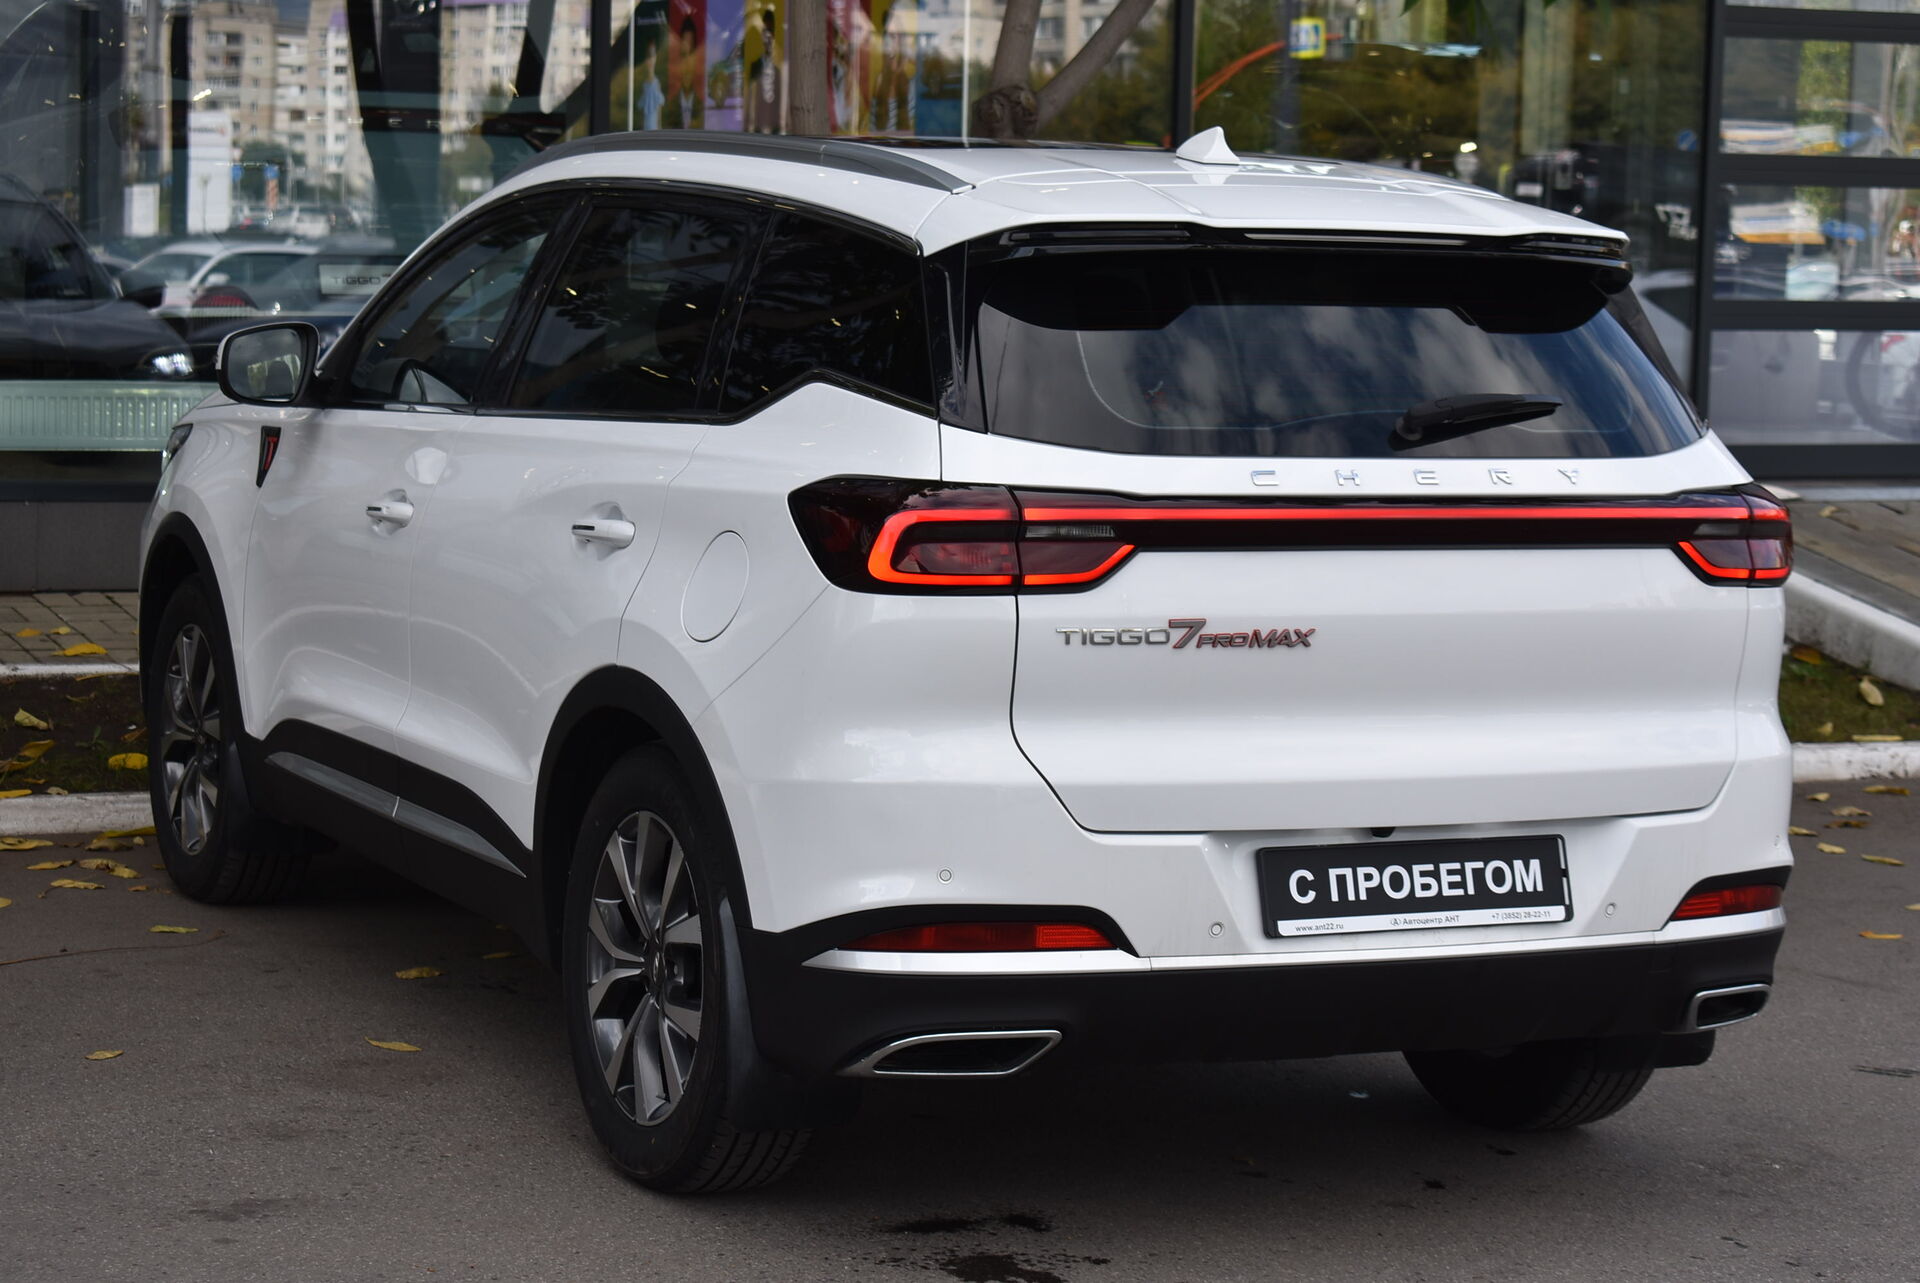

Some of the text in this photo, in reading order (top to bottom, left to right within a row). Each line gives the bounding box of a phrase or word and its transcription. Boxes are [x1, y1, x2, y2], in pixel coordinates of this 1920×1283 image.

[332, 276, 380, 285] TIGGO
[1250, 468, 1579, 487] CHERY
[1055, 627, 1170, 646] TIGGO
[1288, 859, 1543, 905] С ПРОБЕГОМ
[1295, 922, 1345, 932] www.ant22.ru
[1403, 915, 1443, 926] Автоцентр
